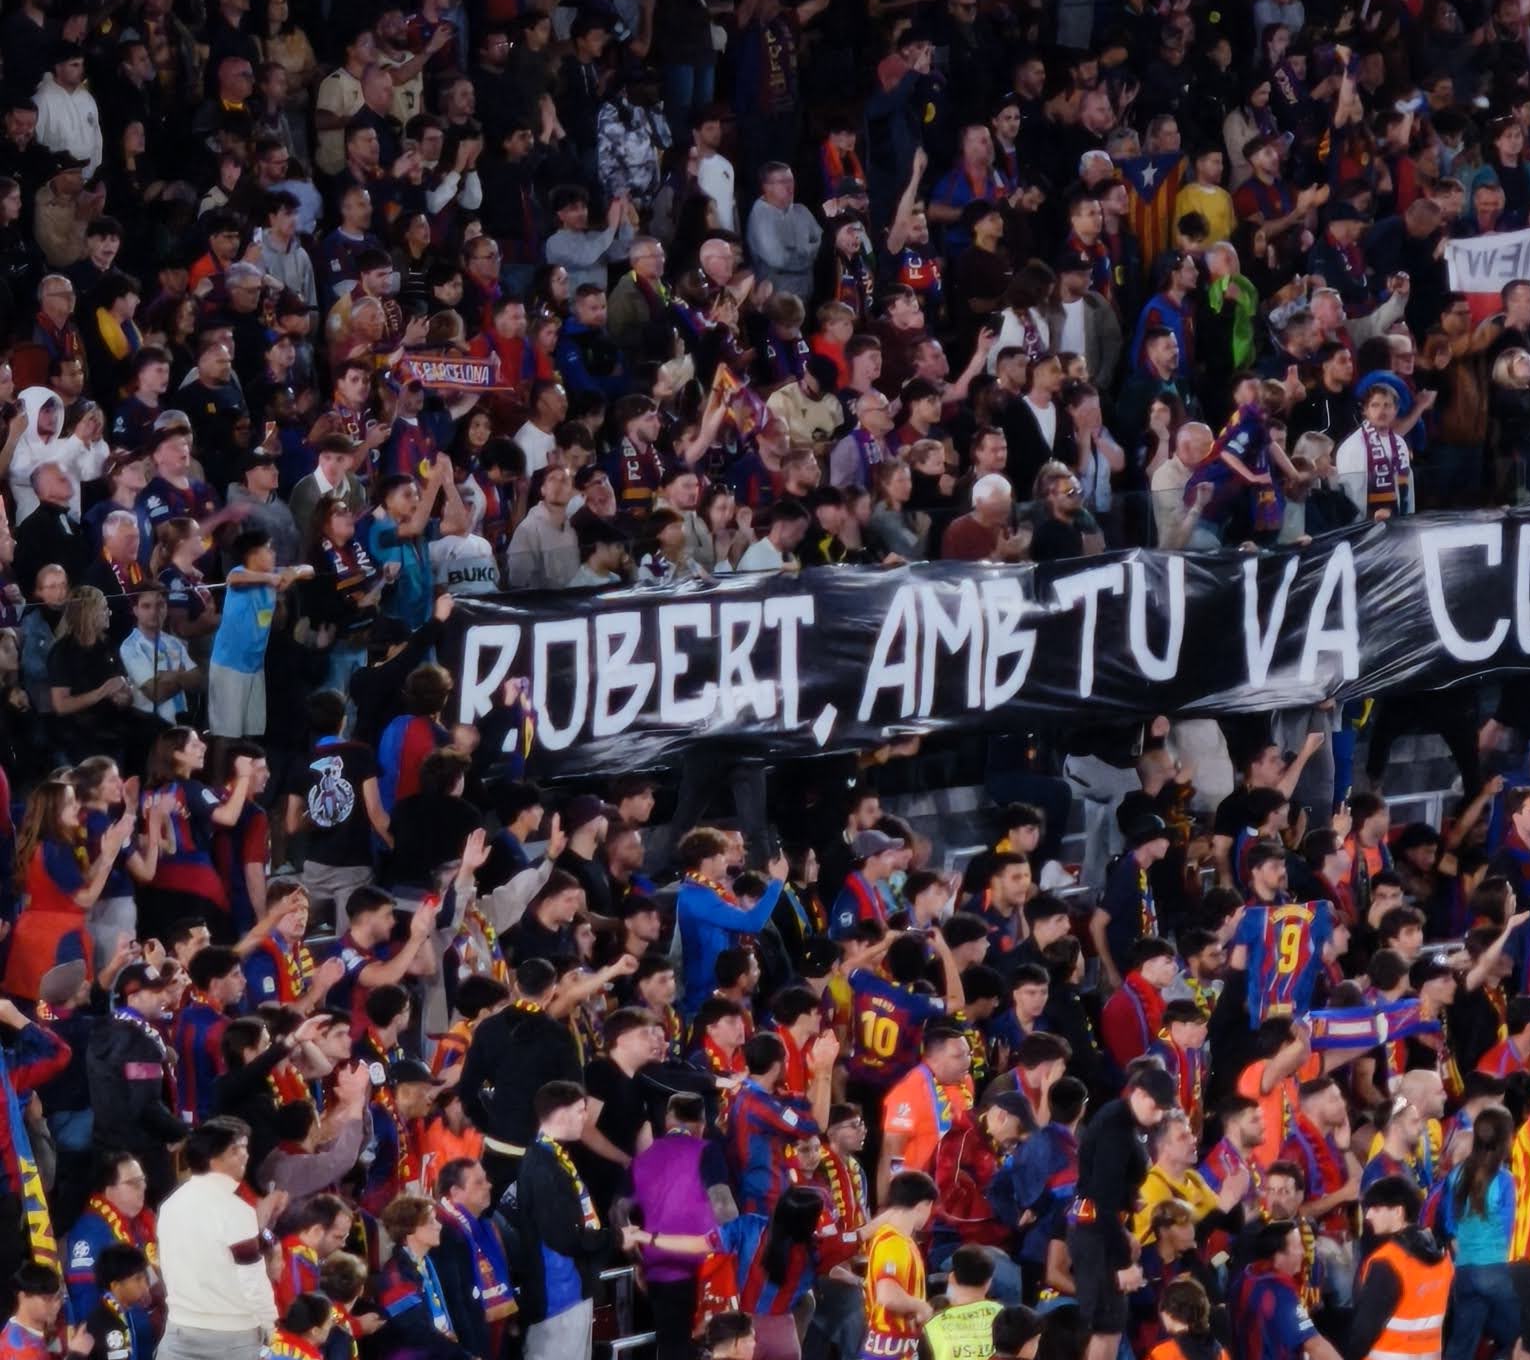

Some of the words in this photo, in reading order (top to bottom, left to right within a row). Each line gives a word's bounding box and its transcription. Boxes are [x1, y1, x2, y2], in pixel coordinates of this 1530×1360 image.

[857, 578, 1036, 723] AMB
[1053, 557, 1185, 698] TU
[1243, 542, 1360, 688] VA
[1278, 923, 1302, 974] 9
[861, 1010, 899, 1058] 10
